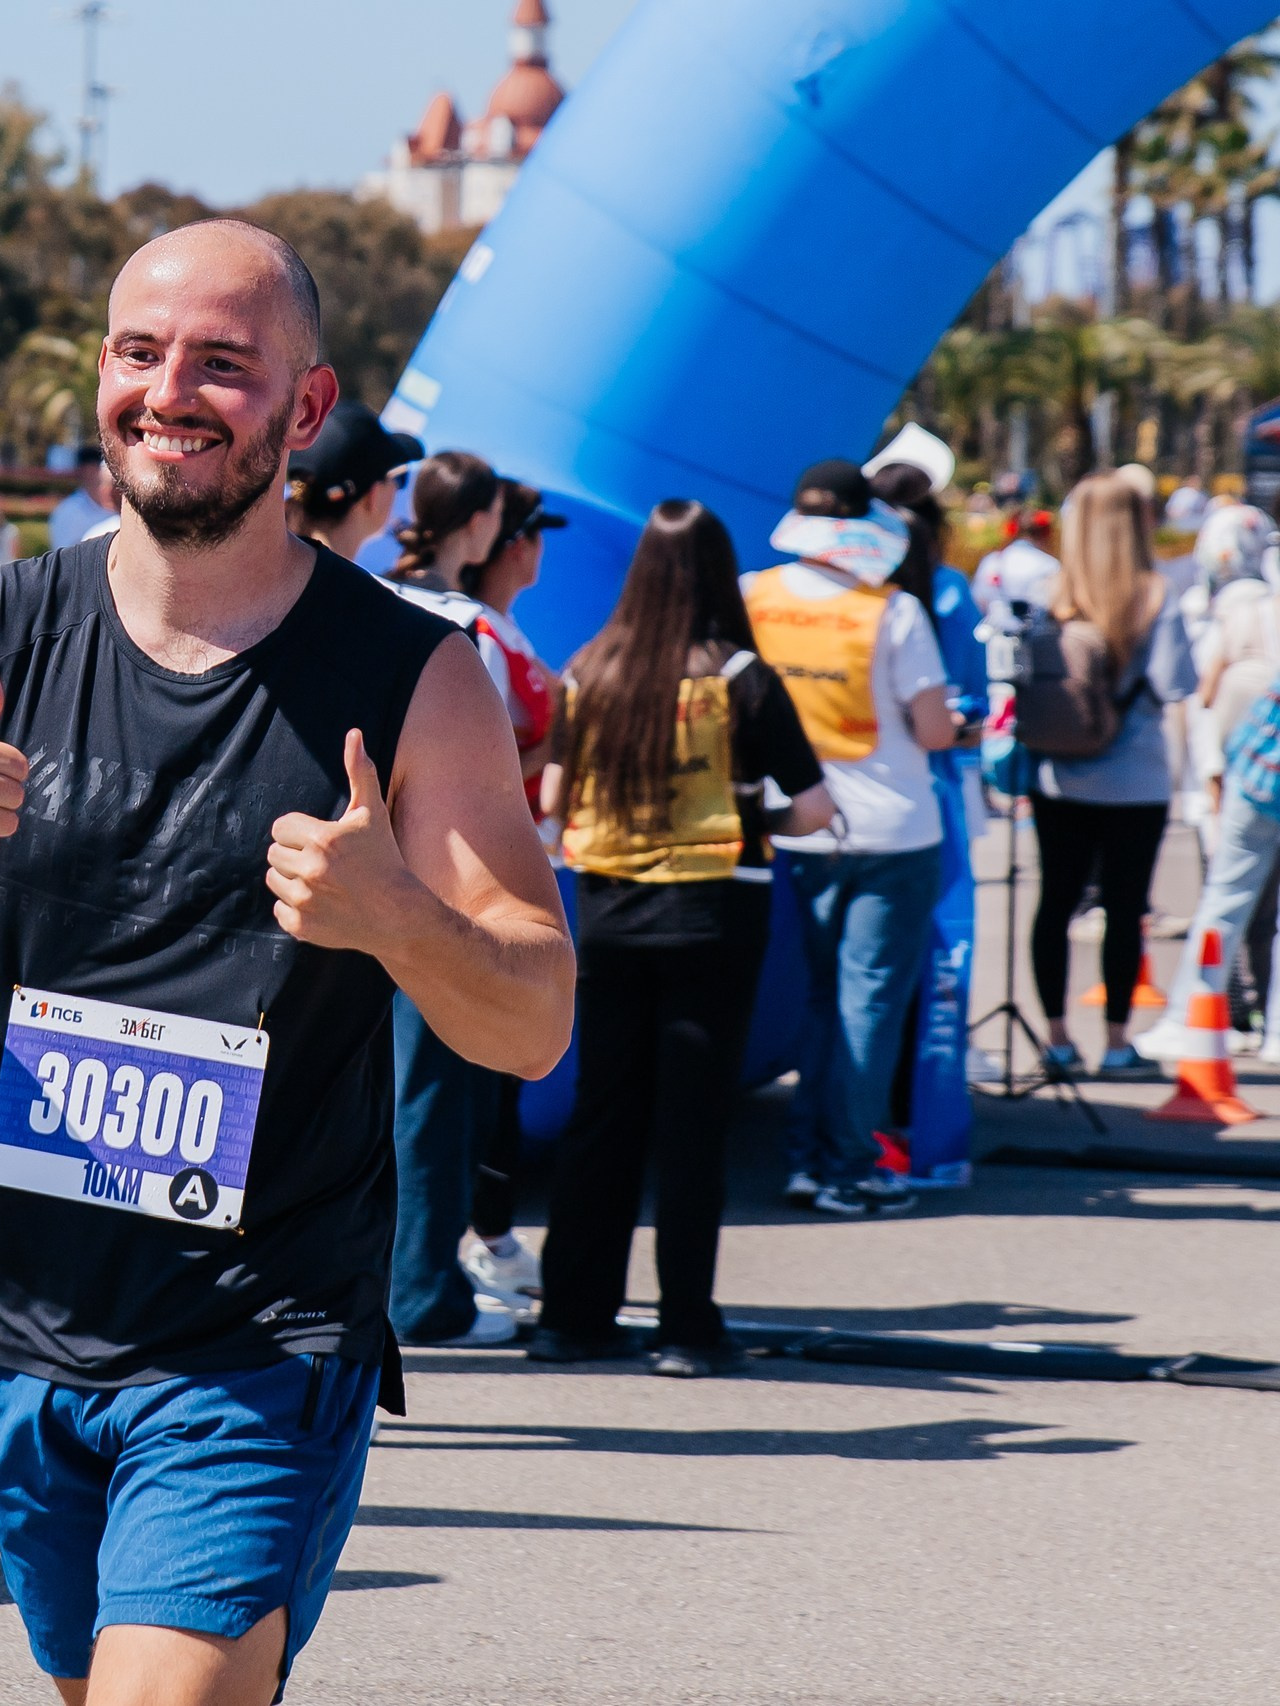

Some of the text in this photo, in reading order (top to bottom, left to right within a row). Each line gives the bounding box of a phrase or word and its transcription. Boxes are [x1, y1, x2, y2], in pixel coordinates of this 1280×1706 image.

[51, 1006, 83, 1023] ПСБ
[120, 1017, 166, 1041] ЗАБЕГ
[29, 1051, 223, 1164] 30300
